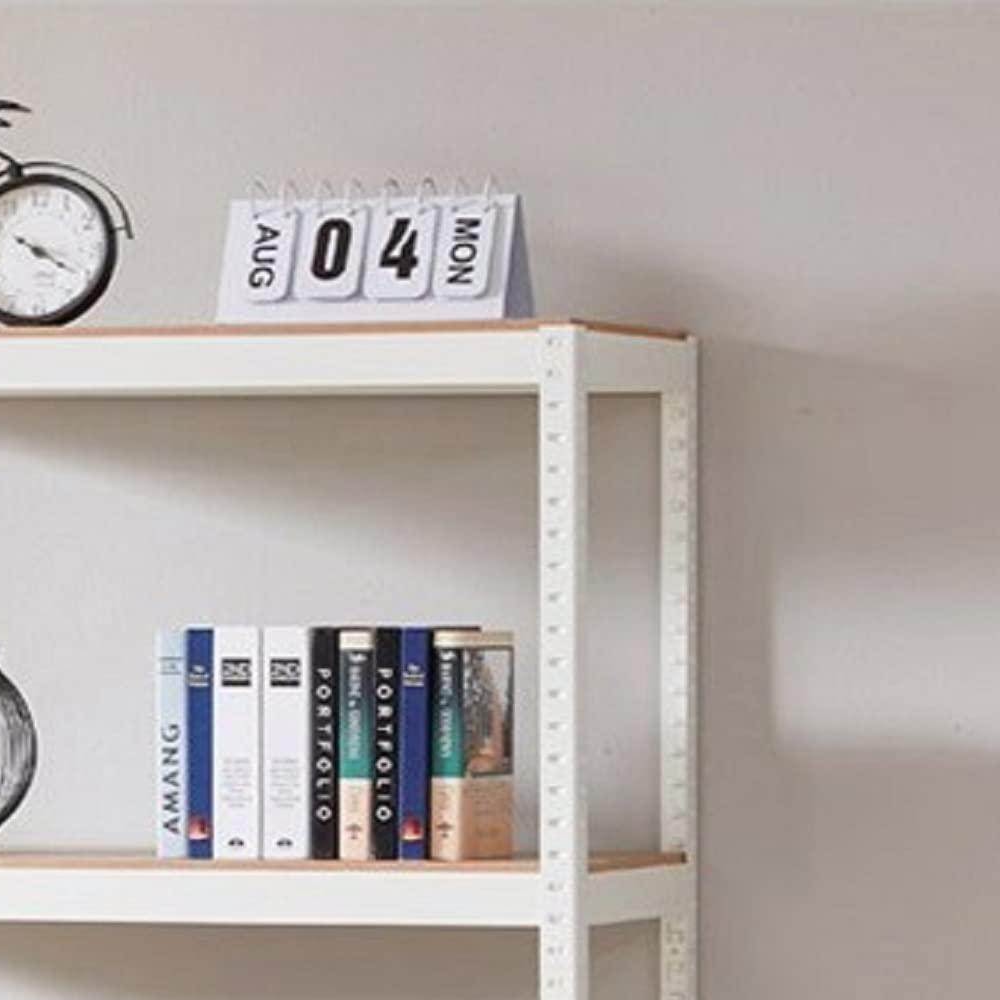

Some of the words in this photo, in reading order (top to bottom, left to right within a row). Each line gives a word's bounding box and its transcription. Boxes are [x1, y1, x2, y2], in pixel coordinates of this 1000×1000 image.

[248, 223, 281, 289] AUG
[446, 217, 482, 285] MON
[162, 723, 181, 834] AMANG
[315, 667, 332, 821] PORTFOLIO
[376, 667, 393, 821] PORTFOLIO
